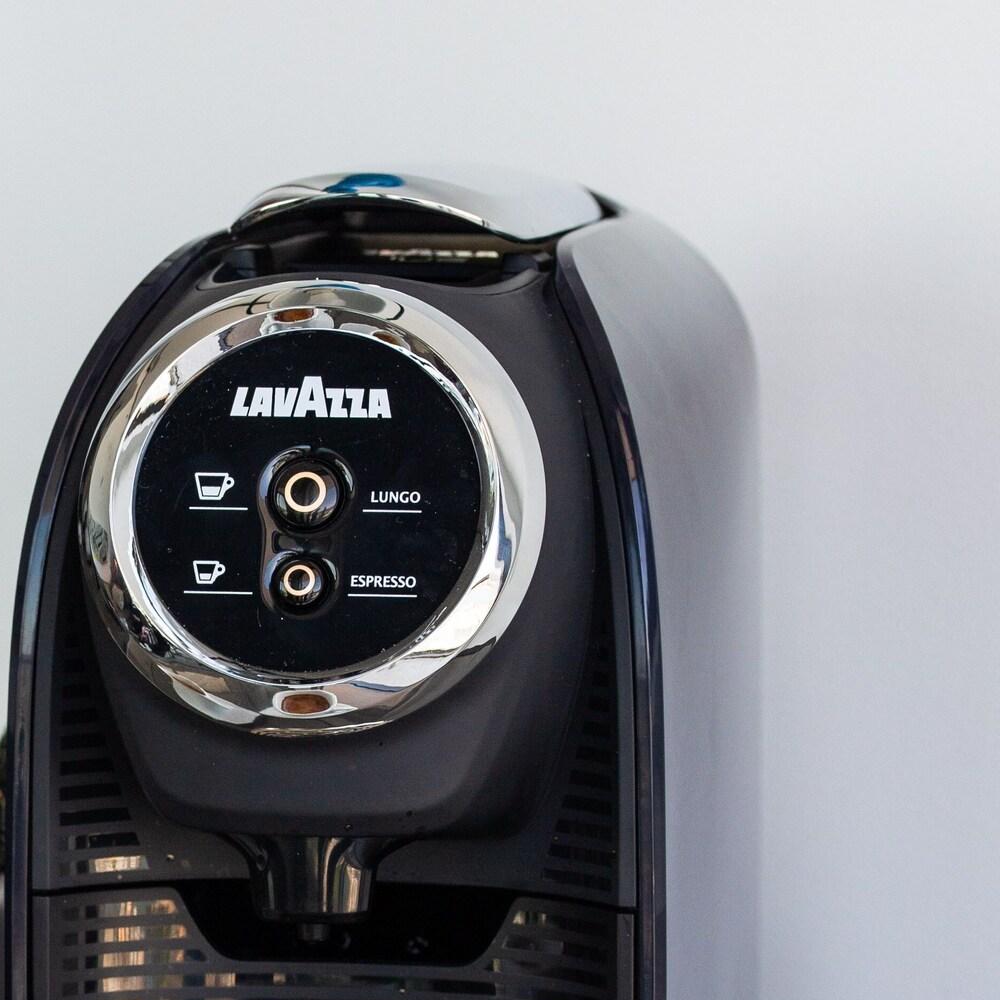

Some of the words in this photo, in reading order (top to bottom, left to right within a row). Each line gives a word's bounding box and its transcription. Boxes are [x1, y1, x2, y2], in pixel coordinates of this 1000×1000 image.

[229, 375, 392, 419] LAVAZZA
[370, 490, 421, 504] LUNGO
[350, 575, 417, 588] ESPRESSO
